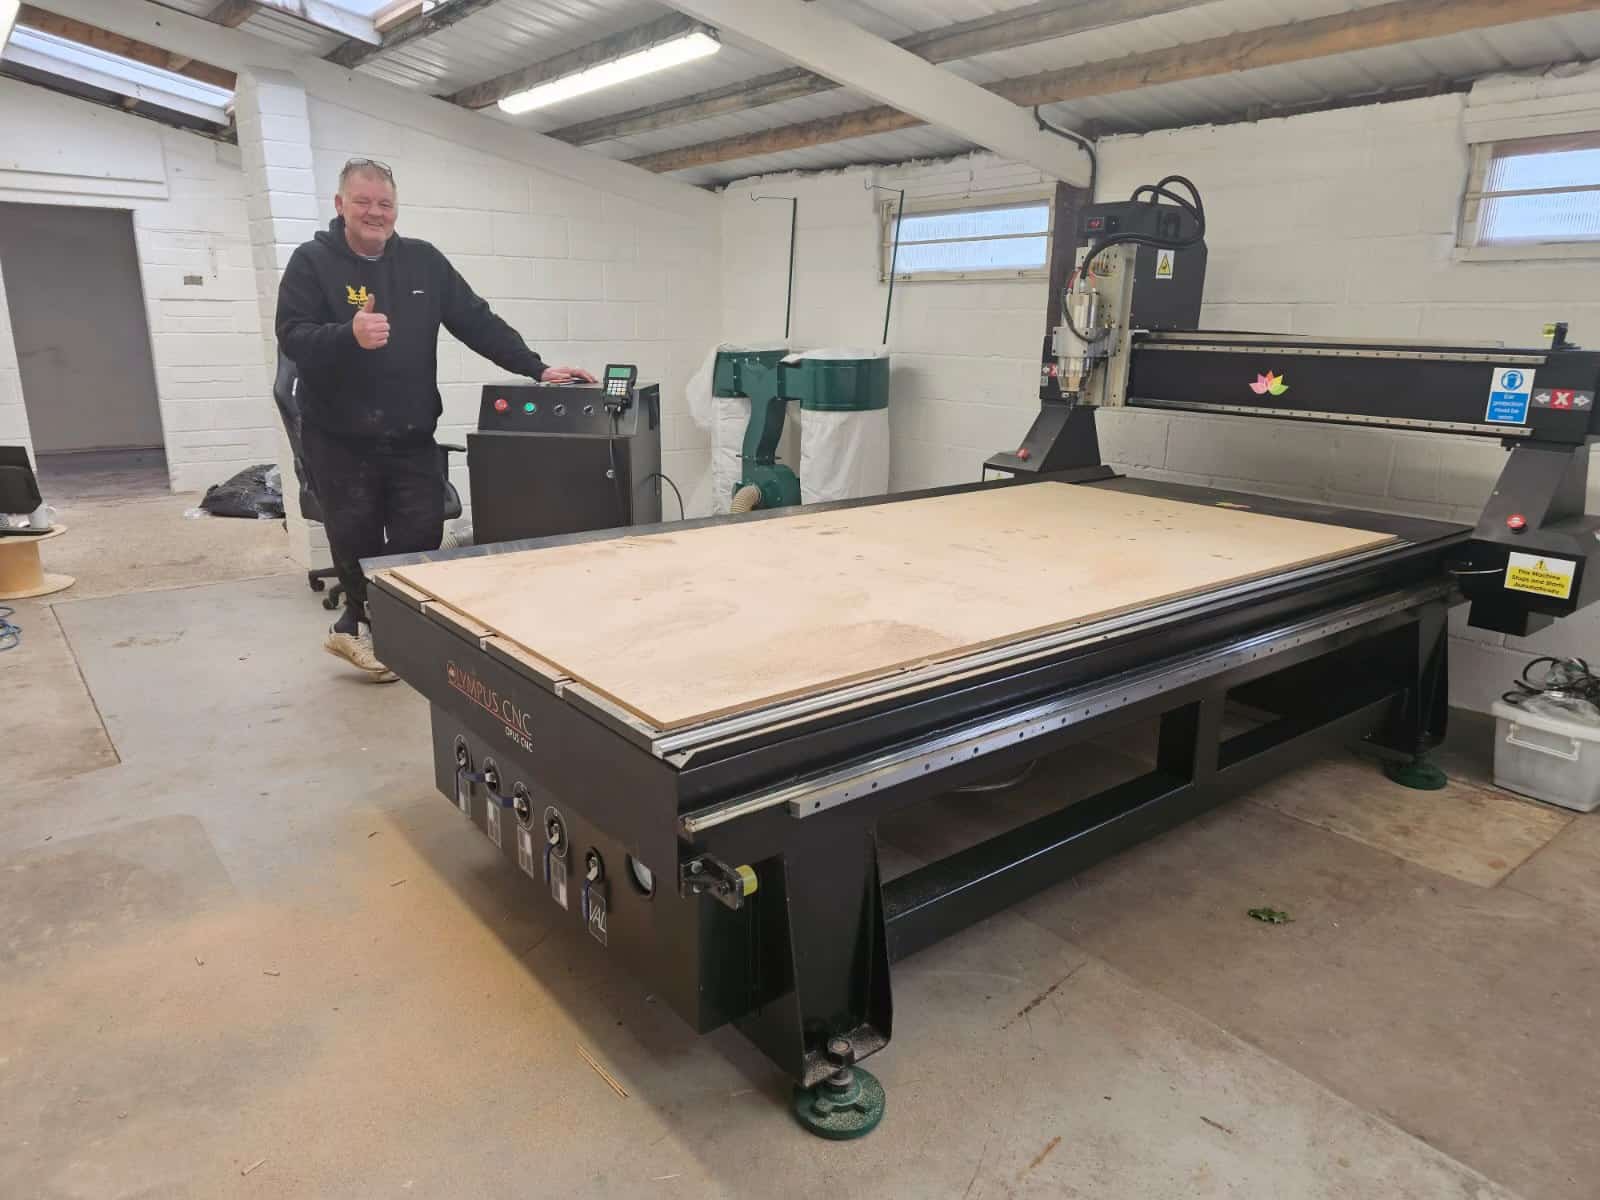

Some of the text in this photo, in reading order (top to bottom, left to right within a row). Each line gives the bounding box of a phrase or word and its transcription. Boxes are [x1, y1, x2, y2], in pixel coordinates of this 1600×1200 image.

[502, 699, 532, 736] CNC
[504, 726, 534, 753] OPUS CNC
